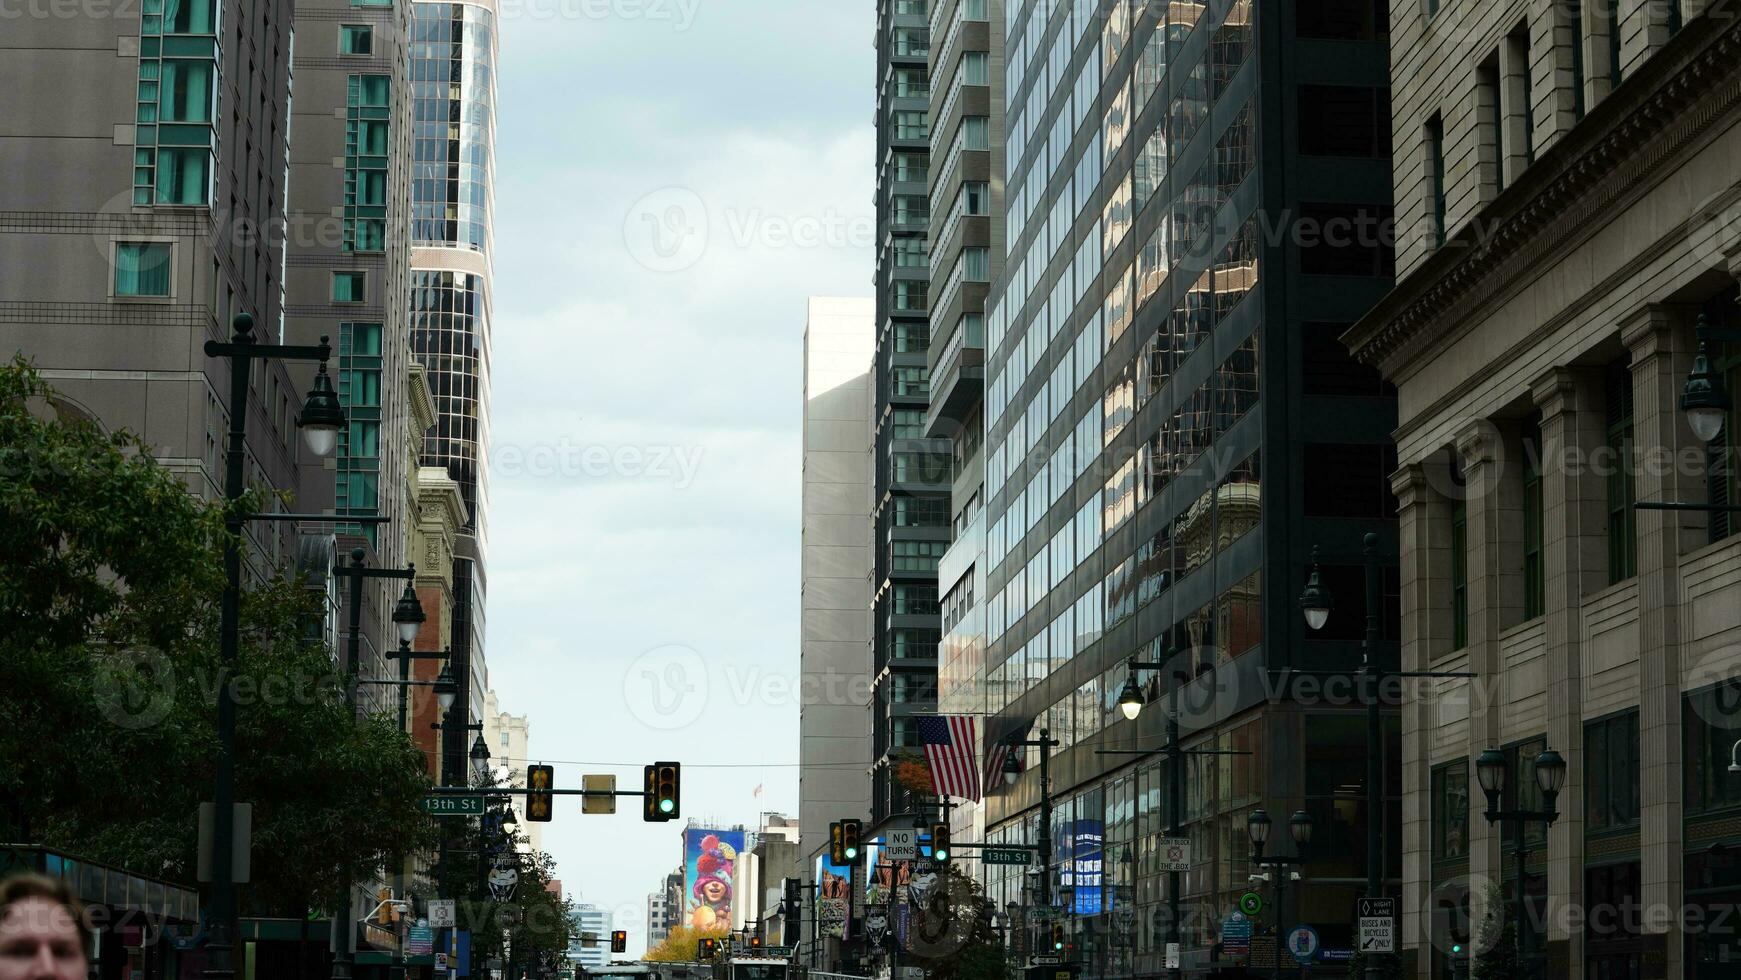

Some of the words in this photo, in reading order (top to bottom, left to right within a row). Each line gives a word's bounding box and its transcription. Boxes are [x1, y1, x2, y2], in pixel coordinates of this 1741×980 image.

[425, 798, 455, 810] 13th
[460, 798, 476, 810] St
[893, 833, 909, 844] NO
[887, 846, 915, 855] TURNS
[987, 852, 1011, 862] 13th
[1015, 852, 1027, 862] St
[1160, 862, 1172, 870] THE
[1175, 862, 1189, 870] BOX
[1361, 920, 1379, 928] BUSES
[1364, 929, 1389, 937] BICYCLES
[1374, 939, 1391, 949] ONLY
